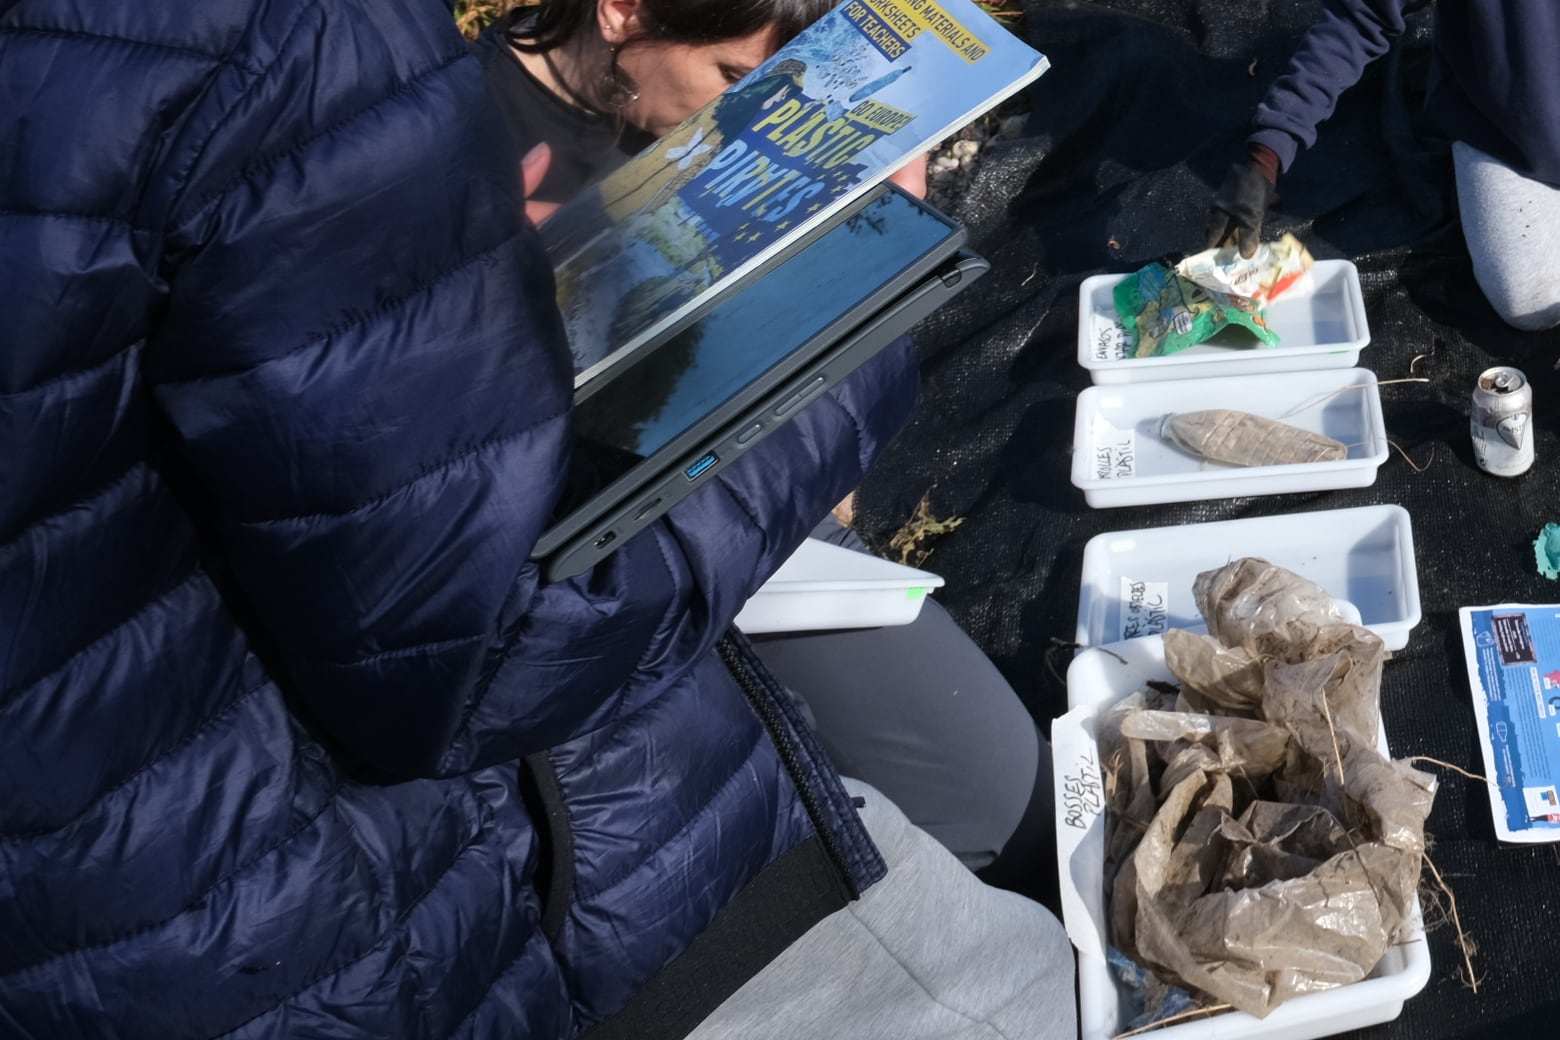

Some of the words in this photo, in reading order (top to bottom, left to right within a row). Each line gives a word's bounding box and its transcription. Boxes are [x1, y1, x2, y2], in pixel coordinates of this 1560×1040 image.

[843, 1, 865, 22] FOR
[859, 14, 907, 59] TEACHERS
[919, 5, 971, 49] MATERIALS
[961, 43, 986, 61] AND
[752, 98, 876, 169] PLASTIC
[850, 100, 869, 117] GO
[867, 107, 914, 132] EUROPE!
[1064, 775, 1087, 829] BOSSES
